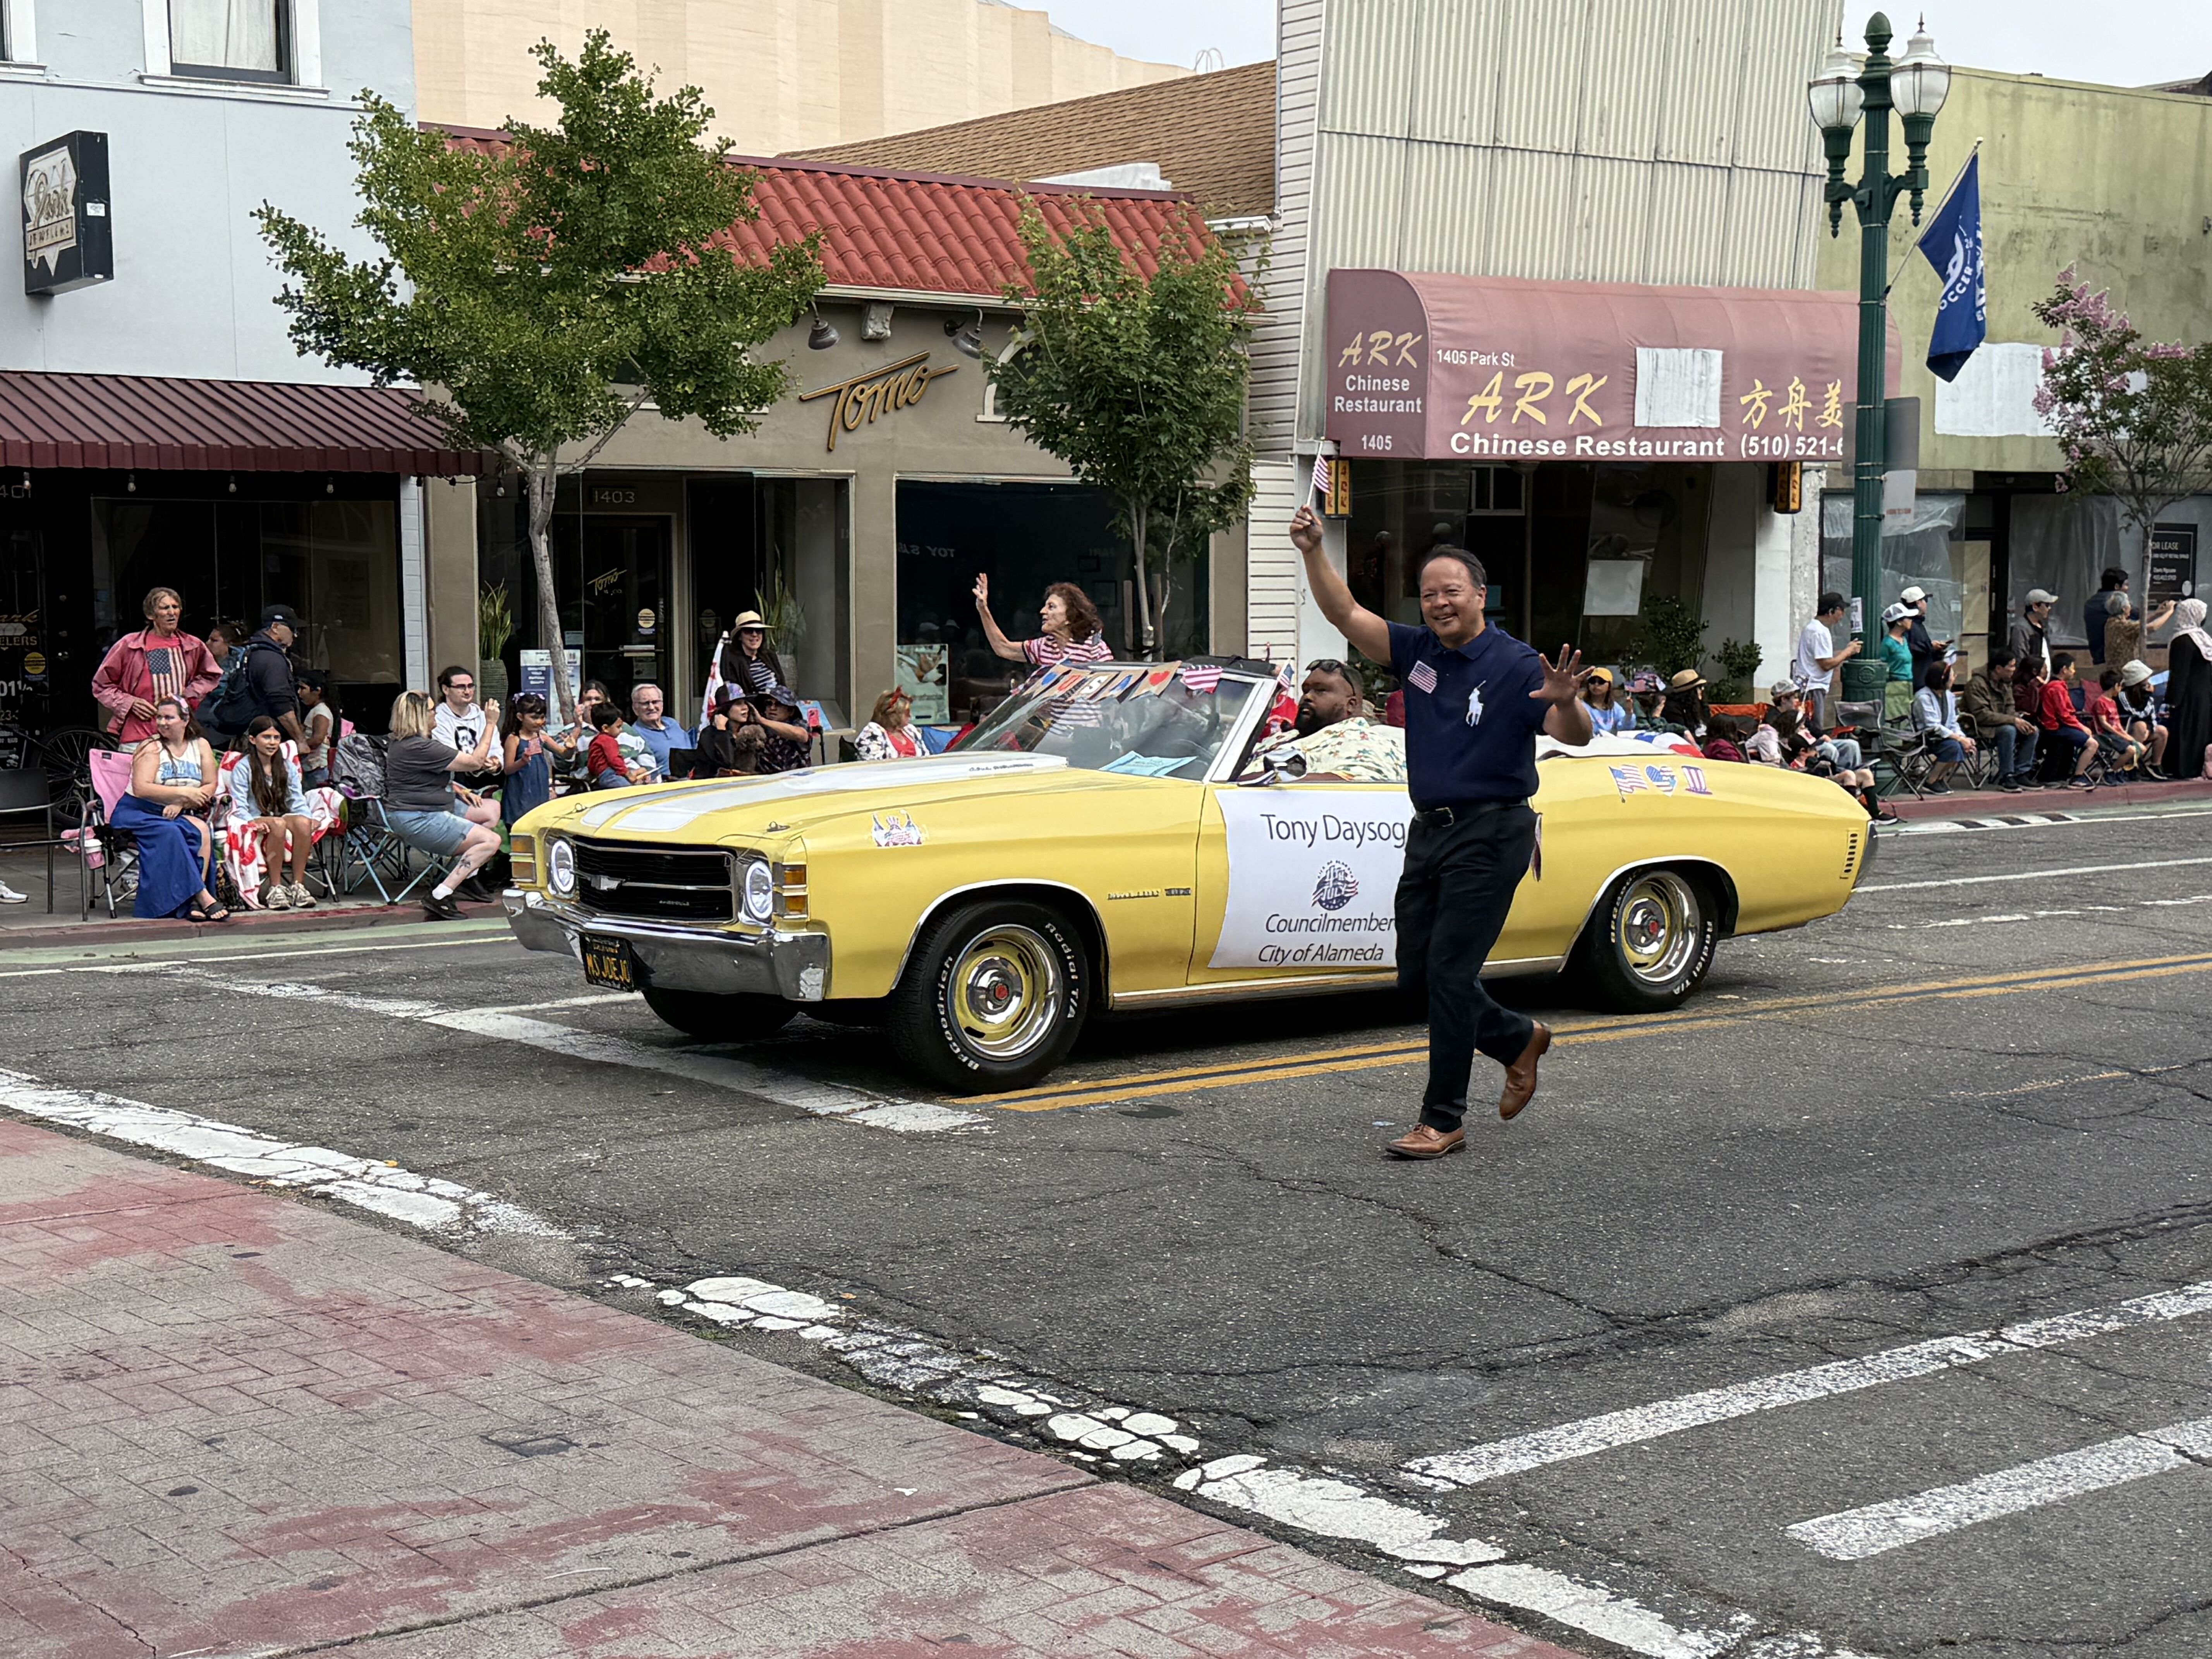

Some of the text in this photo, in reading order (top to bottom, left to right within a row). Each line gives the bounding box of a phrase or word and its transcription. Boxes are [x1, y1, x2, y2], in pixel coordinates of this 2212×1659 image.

[1939, 266, 1973, 310] OCCER
[1338, 330, 1422, 368] ARK
[1437, 349, 1514, 367] 1405 Park St
[1346, 375, 1410, 391] Chinese
[799, 350, 959, 451] Tomo
[1335, 396, 1422, 413] Restaurant
[1461, 371, 1608, 426] ARK
[1362, 435, 1392, 450] 1405
[1451, 433, 1567, 455] Chinese
[1575, 436, 1725, 457] Restaurant
[1741, 433, 1790, 458] (510)
[594, 490, 635, 503] 1403
[1260, 814, 1406, 848] Tony Daysog
[1265, 912, 1395, 933] Councilmember
[1259, 943, 1384, 966] City of Alameda
[1692, 921, 1713, 977] Radial
[1045, 923, 1079, 1018] Radial T/A
[937, 956, 980, 1070] BFGoodrich
